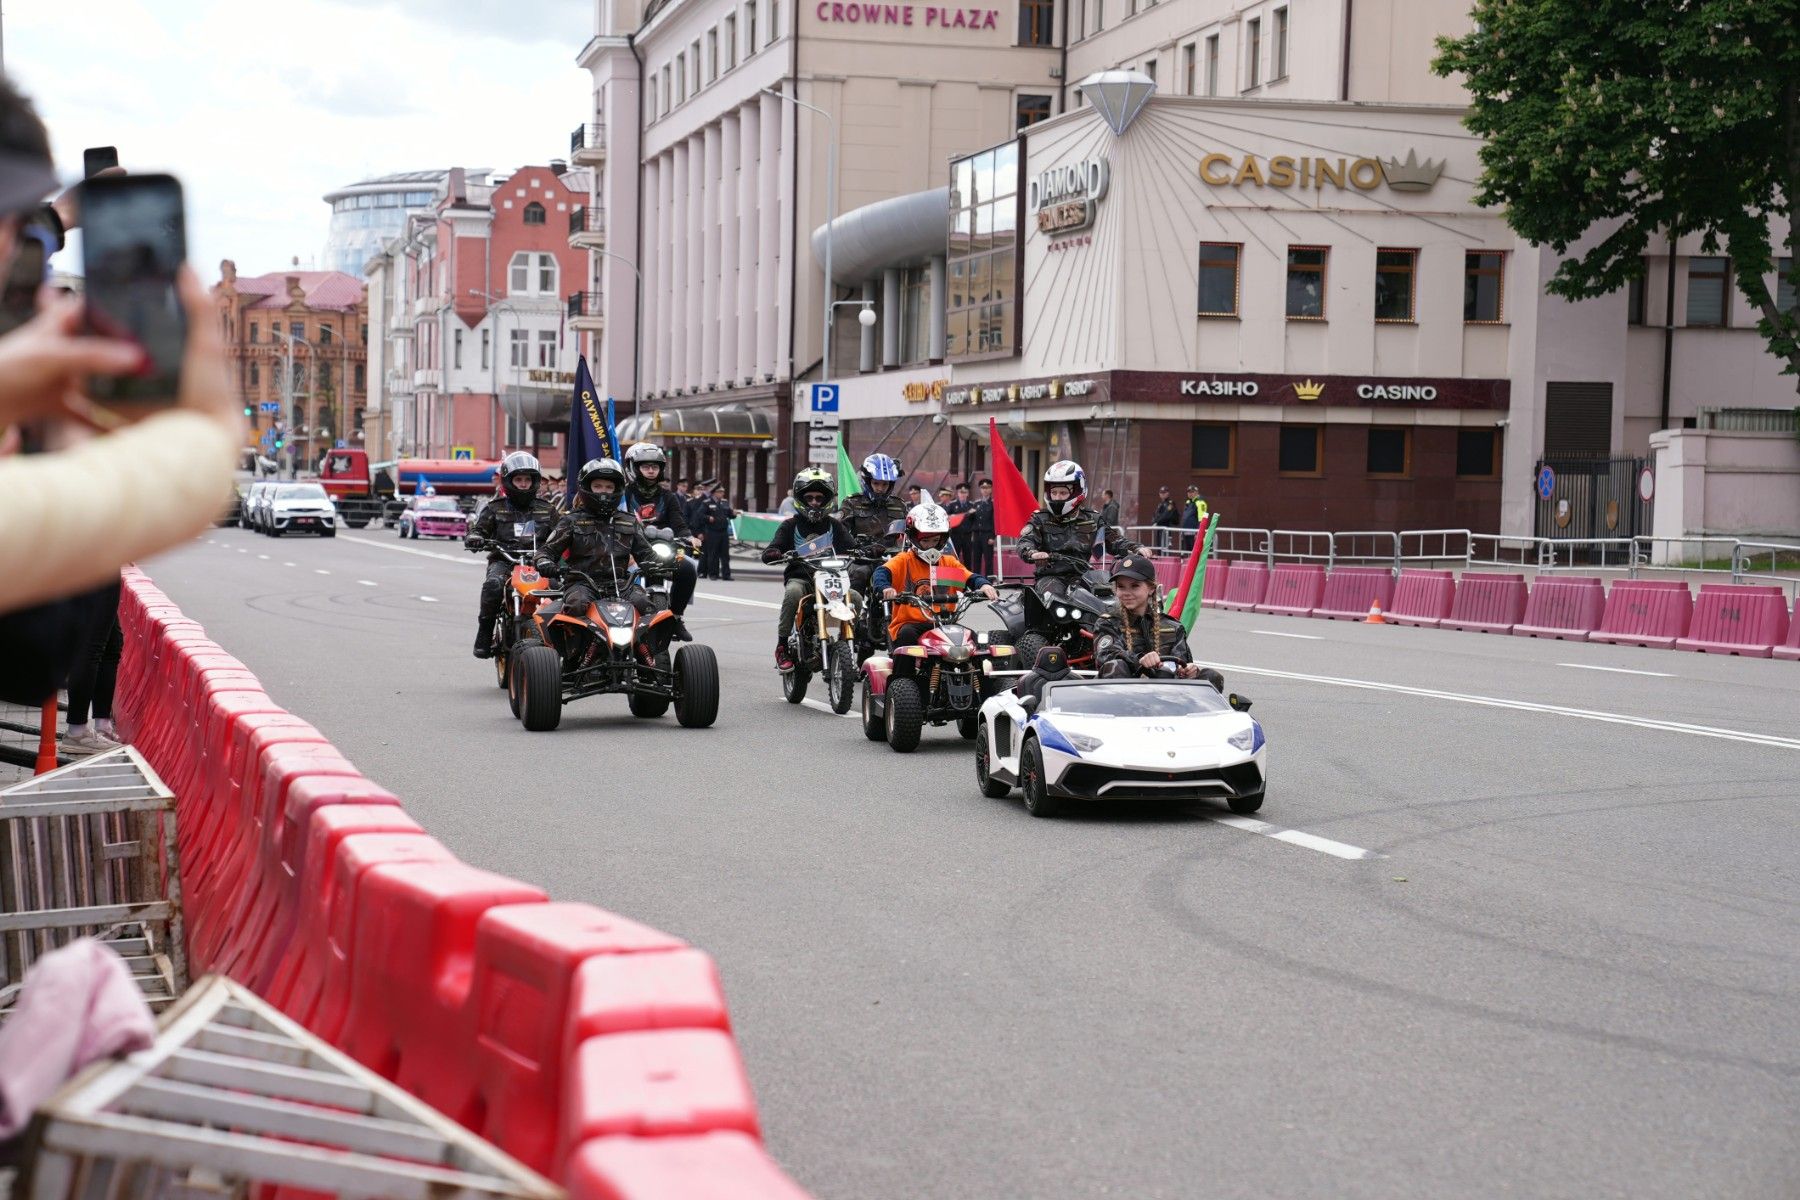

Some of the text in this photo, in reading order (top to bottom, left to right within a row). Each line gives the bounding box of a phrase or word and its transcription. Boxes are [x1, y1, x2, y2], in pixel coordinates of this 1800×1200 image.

[816, 2, 997, 30] CROWNE PLAZA
[1199, 153, 1383, 191] CASINO
[1029, 157, 1105, 216] DIAMOND
[817, 386, 834, 410] P
[1356, 384, 1437, 400] CASINO
[824, 578, 842, 589] 55
